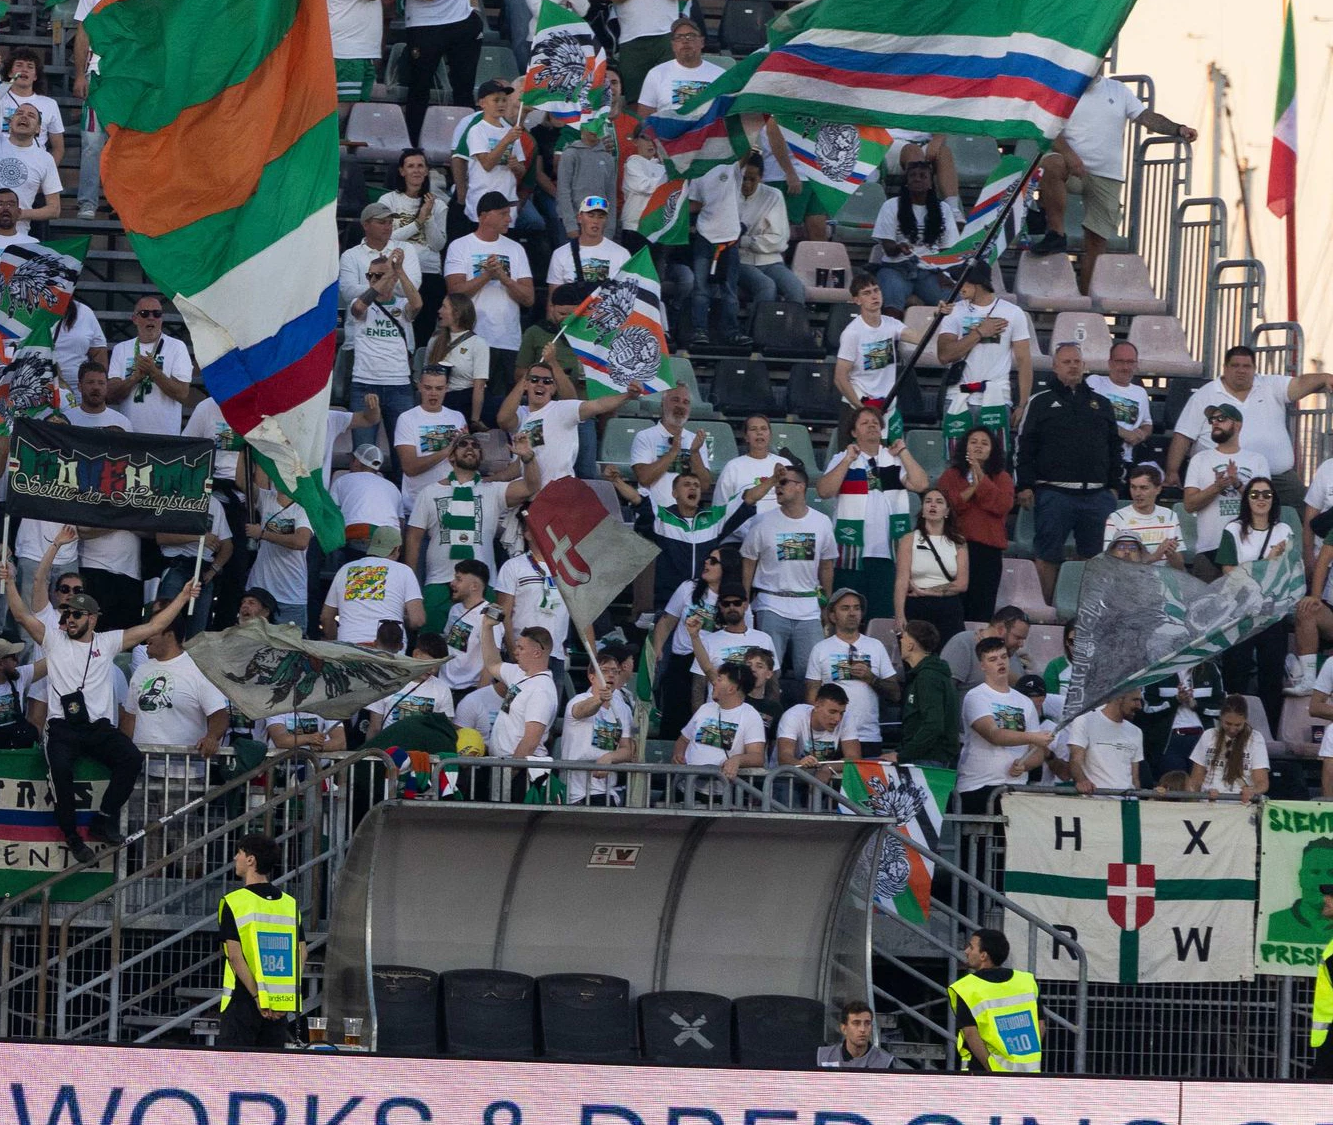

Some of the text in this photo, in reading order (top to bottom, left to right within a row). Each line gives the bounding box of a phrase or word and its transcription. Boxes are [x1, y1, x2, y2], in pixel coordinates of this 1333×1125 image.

[366, 327, 400, 338] ENERG
[1054, 815, 1212, 855] H X
[1052, 924, 1214, 962] R W
[1006, 1033, 1032, 1051] 310
